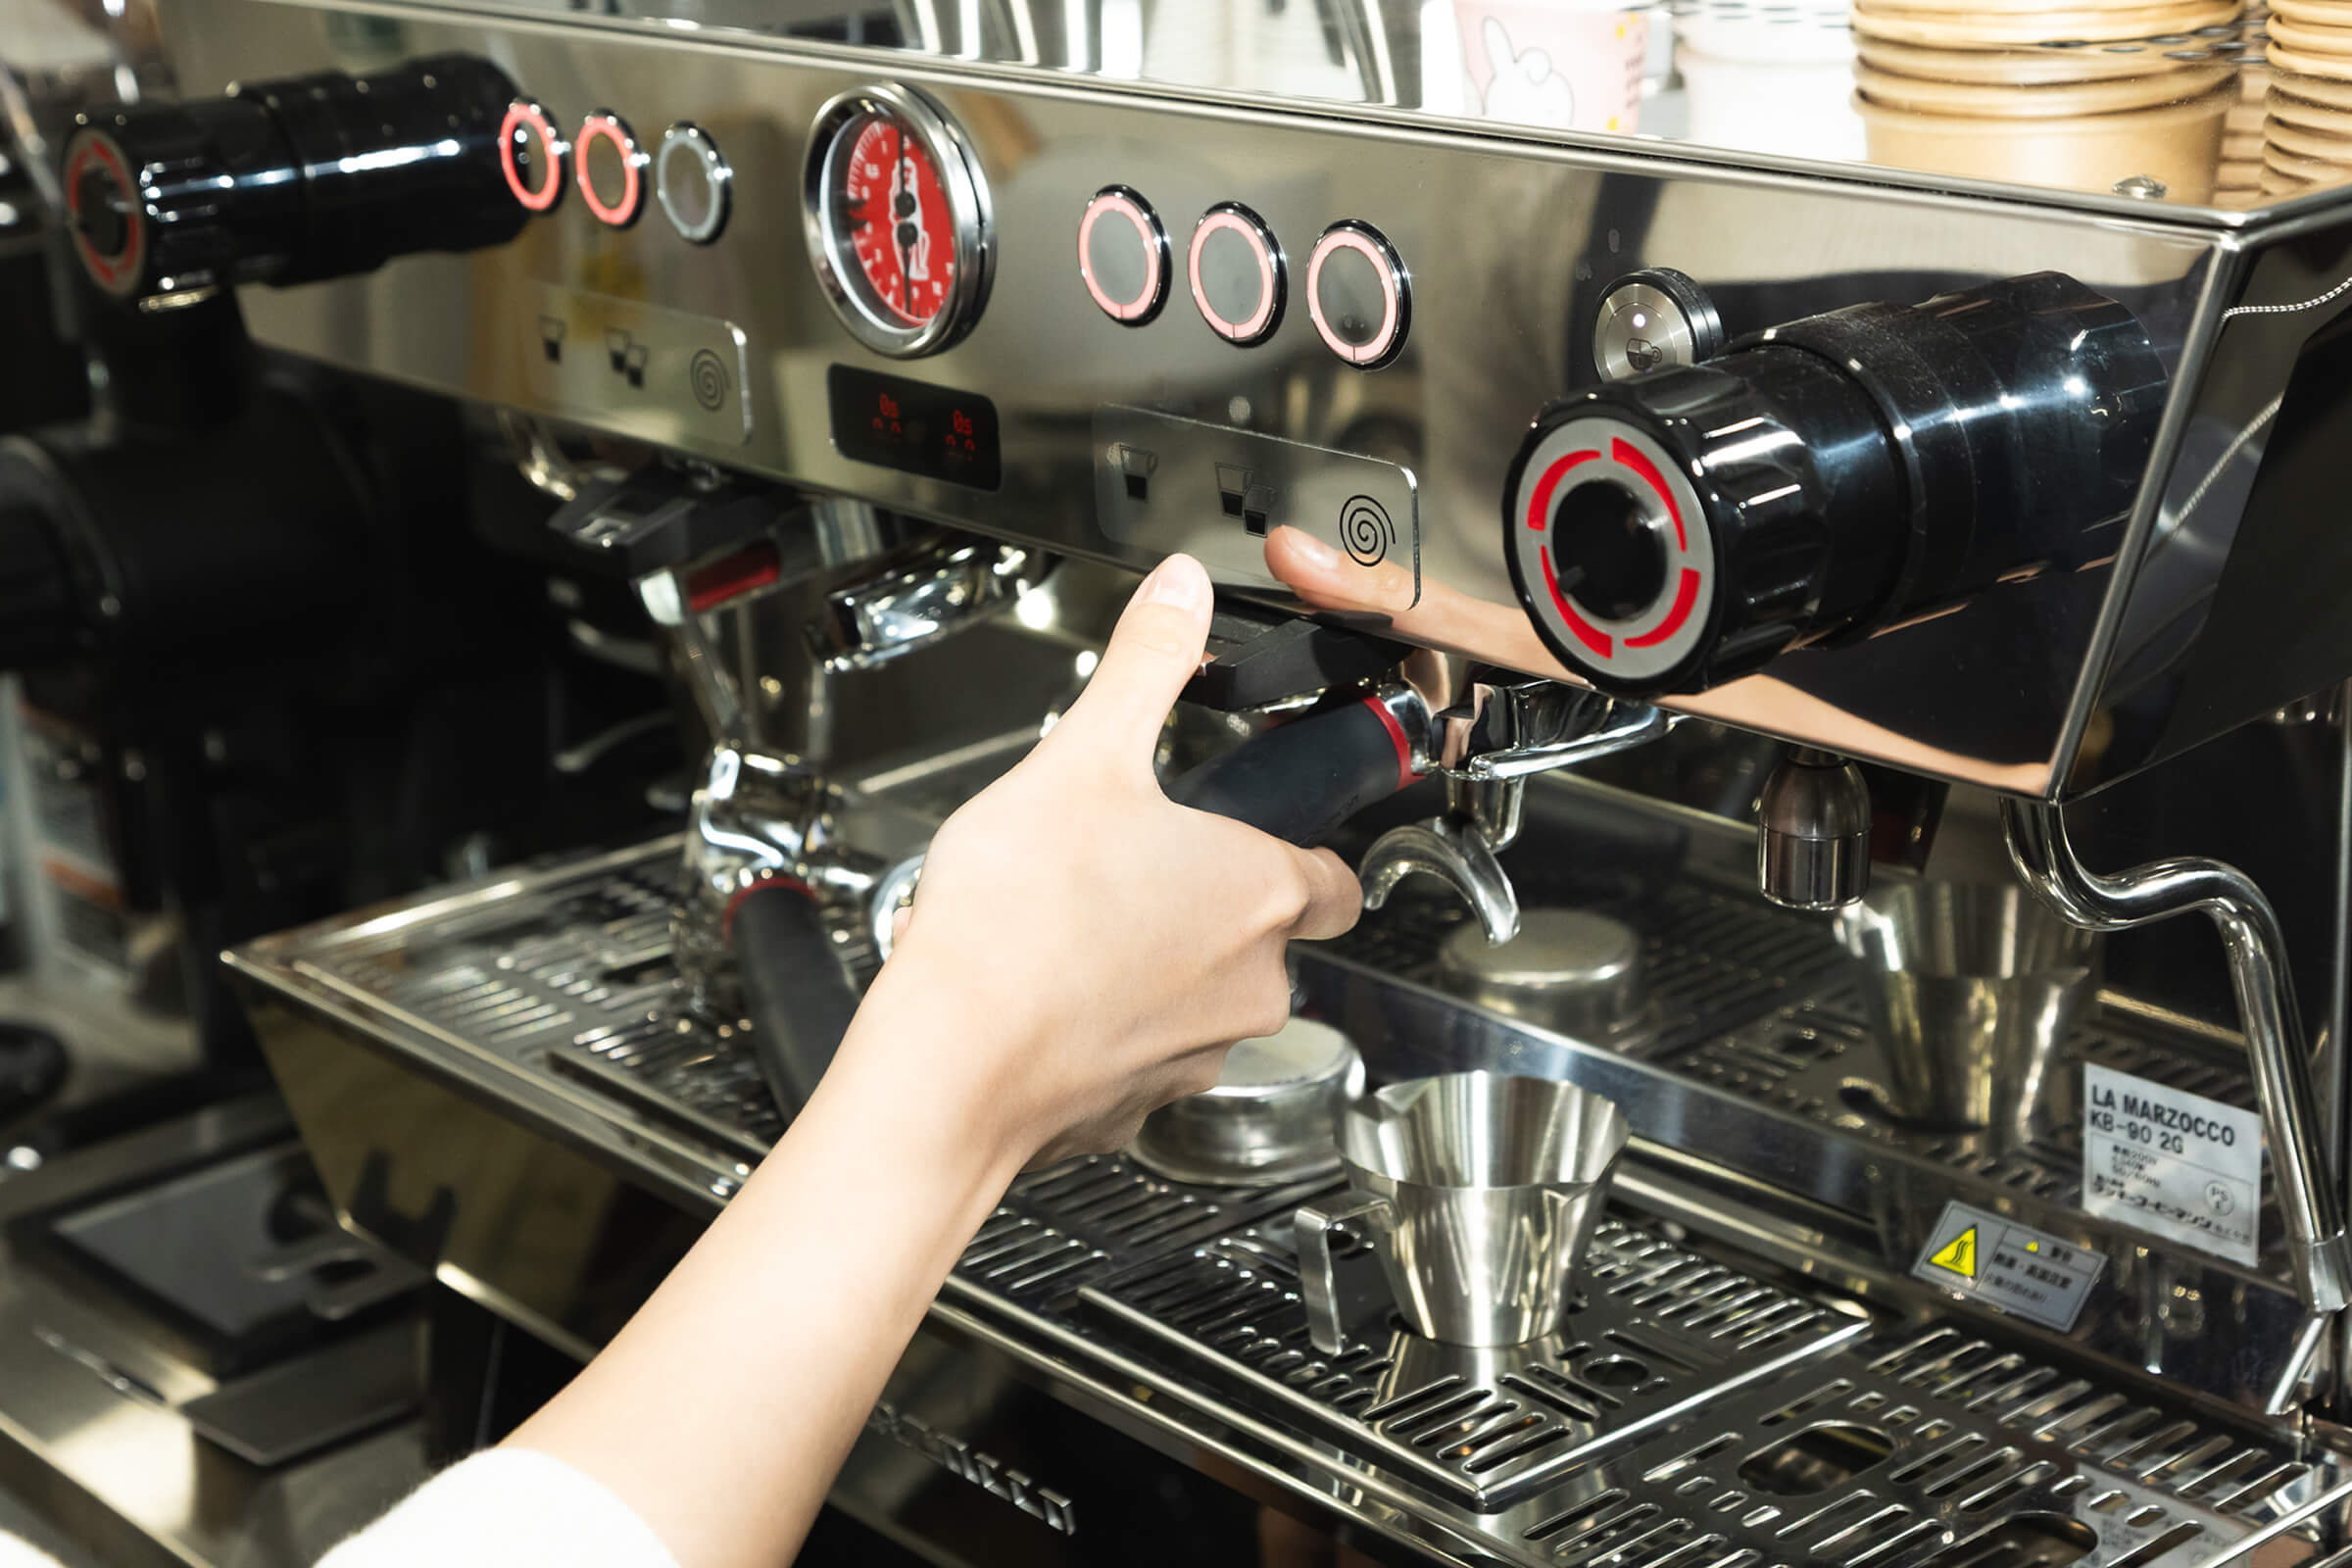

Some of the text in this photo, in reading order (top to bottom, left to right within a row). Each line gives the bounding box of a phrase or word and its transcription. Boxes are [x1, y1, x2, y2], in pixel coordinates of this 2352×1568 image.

[2089, 1109, 2184, 1154] KB-90 2G
[2092, 1084, 2235, 1147] LA MARZOCCO
